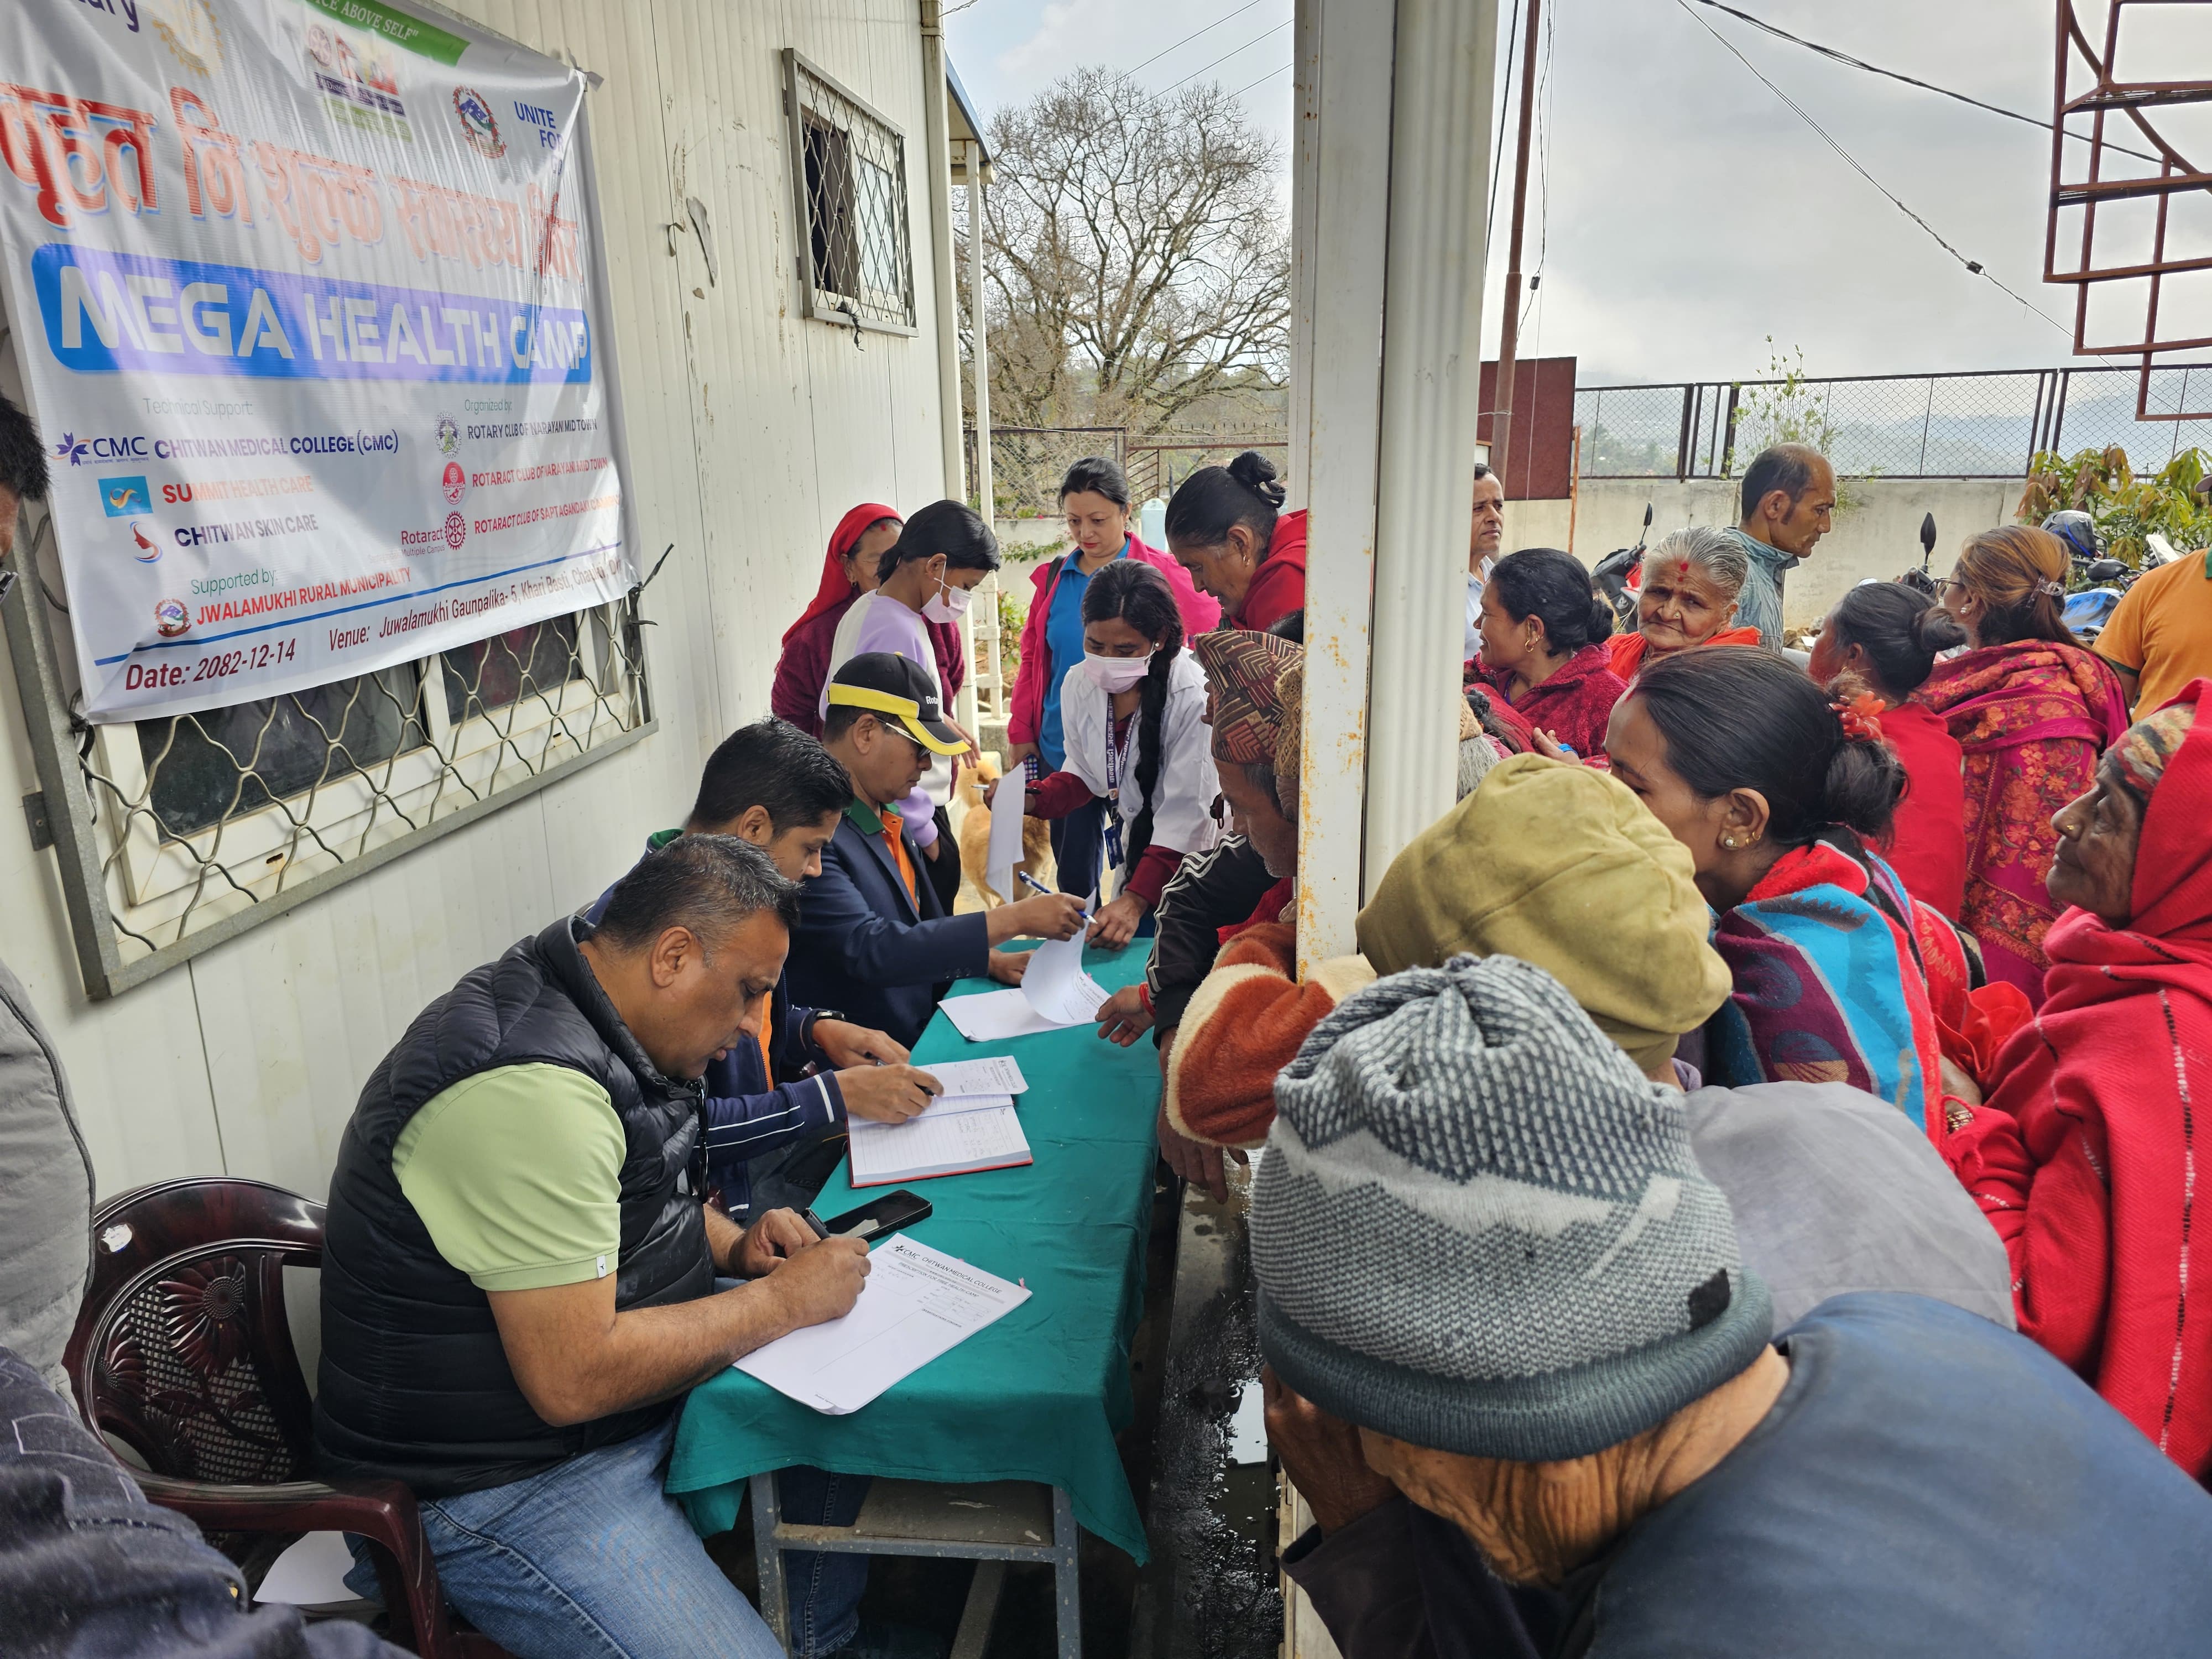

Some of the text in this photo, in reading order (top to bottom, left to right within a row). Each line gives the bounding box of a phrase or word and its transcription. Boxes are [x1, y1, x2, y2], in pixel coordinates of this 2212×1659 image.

[341, 1, 383, 28] ABOVE
[383, 19, 419, 40] SELF"
[514, 101, 556, 129] UNITE
[61, 266, 588, 370] MEGA HEALTH CAMP
[143, 398, 253, 420] Technical Support:
[465, 398, 503, 414] Organized
[154, 429, 398, 459] CHITWAN MEDICAL COLLEGE (CMC)
[468, 419, 597, 440] ROTARY CLUB OF NARAYANI MID TOWN
[93, 436, 148, 457] CMC
[473, 469, 515, 487] ROTARACT
[516, 467, 535, 482] CLUB
[536, 466, 545, 479] OF
[576, 460, 589, 473] MID
[589, 457, 608, 471] TOWN
[162, 476, 314, 504] SUMMIT HEALTH CARE
[174, 514, 319, 547] CHITWAN SKIN CARE
[474, 513, 515, 534] ROTARACT
[516, 512, 531, 525] CLUB
[531, 508, 540, 523] OF
[401, 527, 444, 545] Rotaract
[401, 547, 425, 557] Multiple
[427, 545, 445, 554] Campus
[191, 568, 278, 597] Supported by:
[196, 567, 411, 625] JWALAMUKHI RURAL MUNICIPALITY
[330, 626, 370, 651] Venue:
[379, 600, 448, 638] Juwalamukhi
[452, 588, 508, 618] Gaunpalika-
[511, 585, 520, 605] 5,
[521, 576, 546, 599] Khari
[546, 571, 574, 591] Basti,
[126, 638, 296, 690] Date: 2082-12-14
[903, 1249, 920, 1259] CMC
[922, 1256, 950, 1272] CHITWAN
[948, 1267, 974, 1282] MEDICAL
[974, 1280, 1002, 1294] COLLEGE
